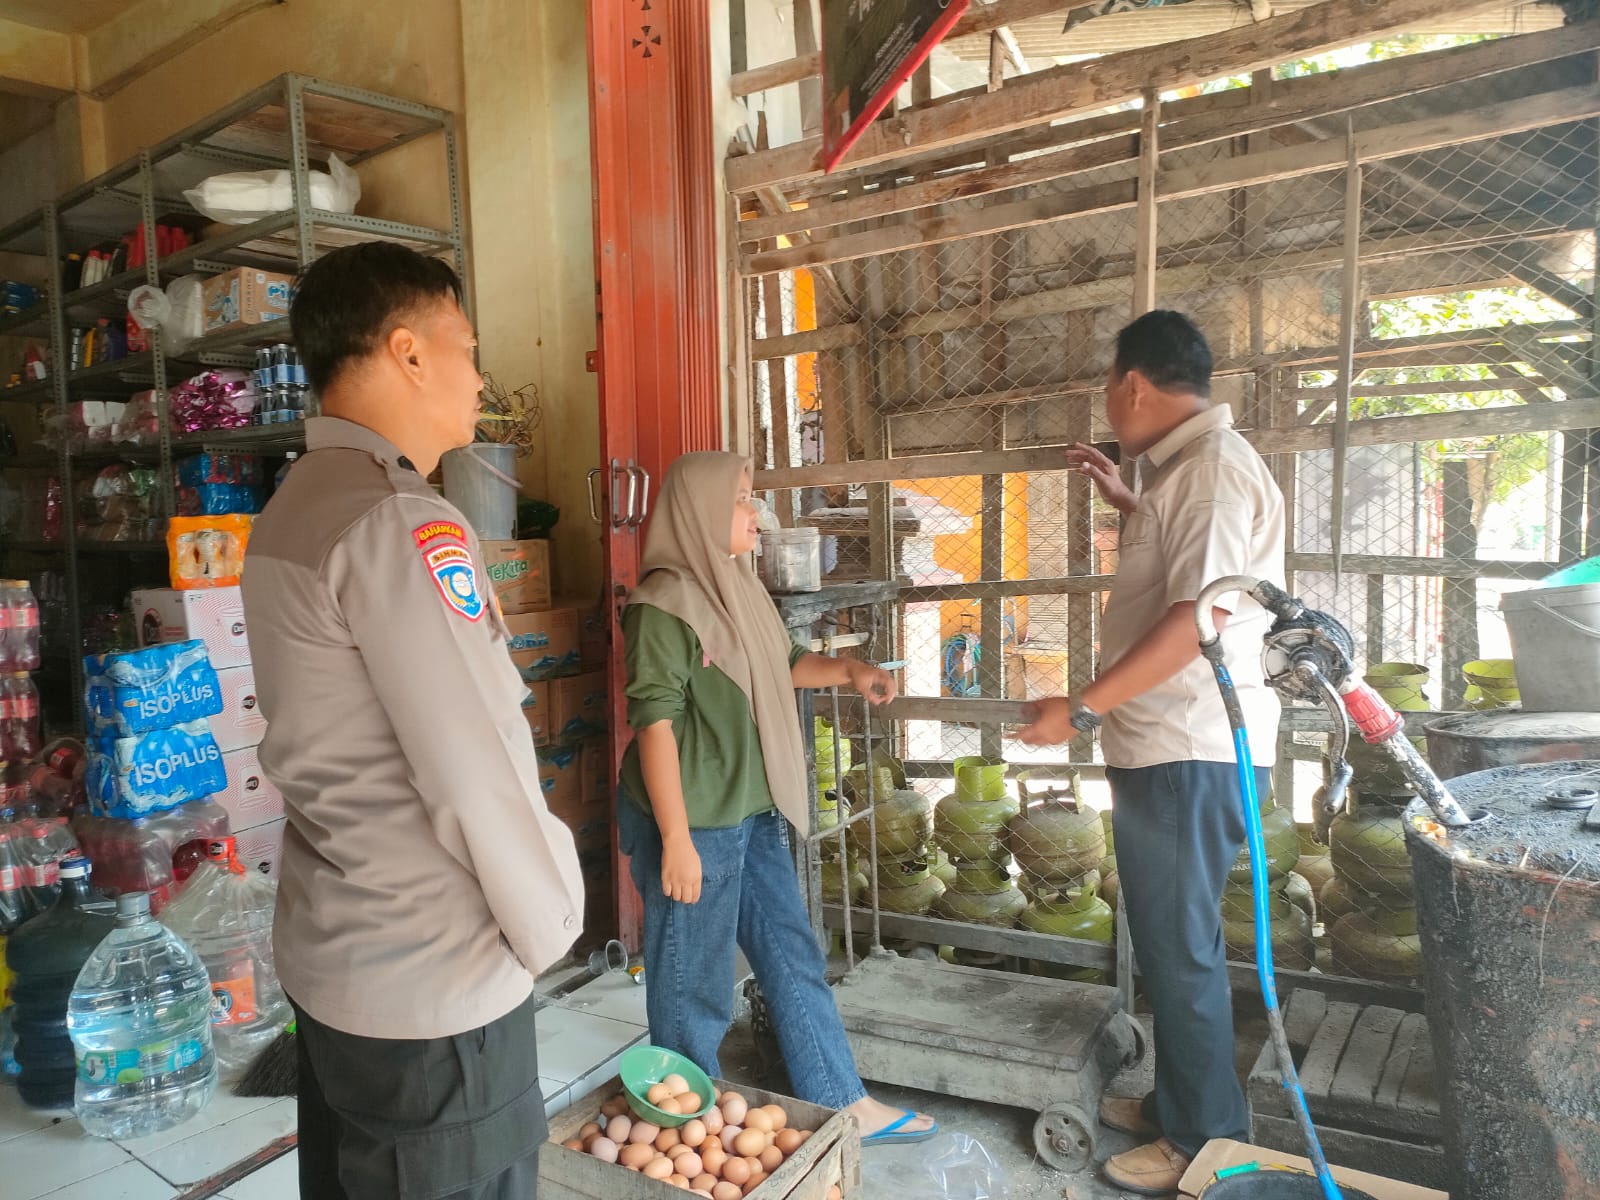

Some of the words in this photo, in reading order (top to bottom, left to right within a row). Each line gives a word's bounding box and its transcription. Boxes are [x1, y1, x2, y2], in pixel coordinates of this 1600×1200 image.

[487, 559, 529, 581] TeKita
[140, 684, 213, 719] ISOPLUS
[134, 744, 219, 786] ISOPLUS
